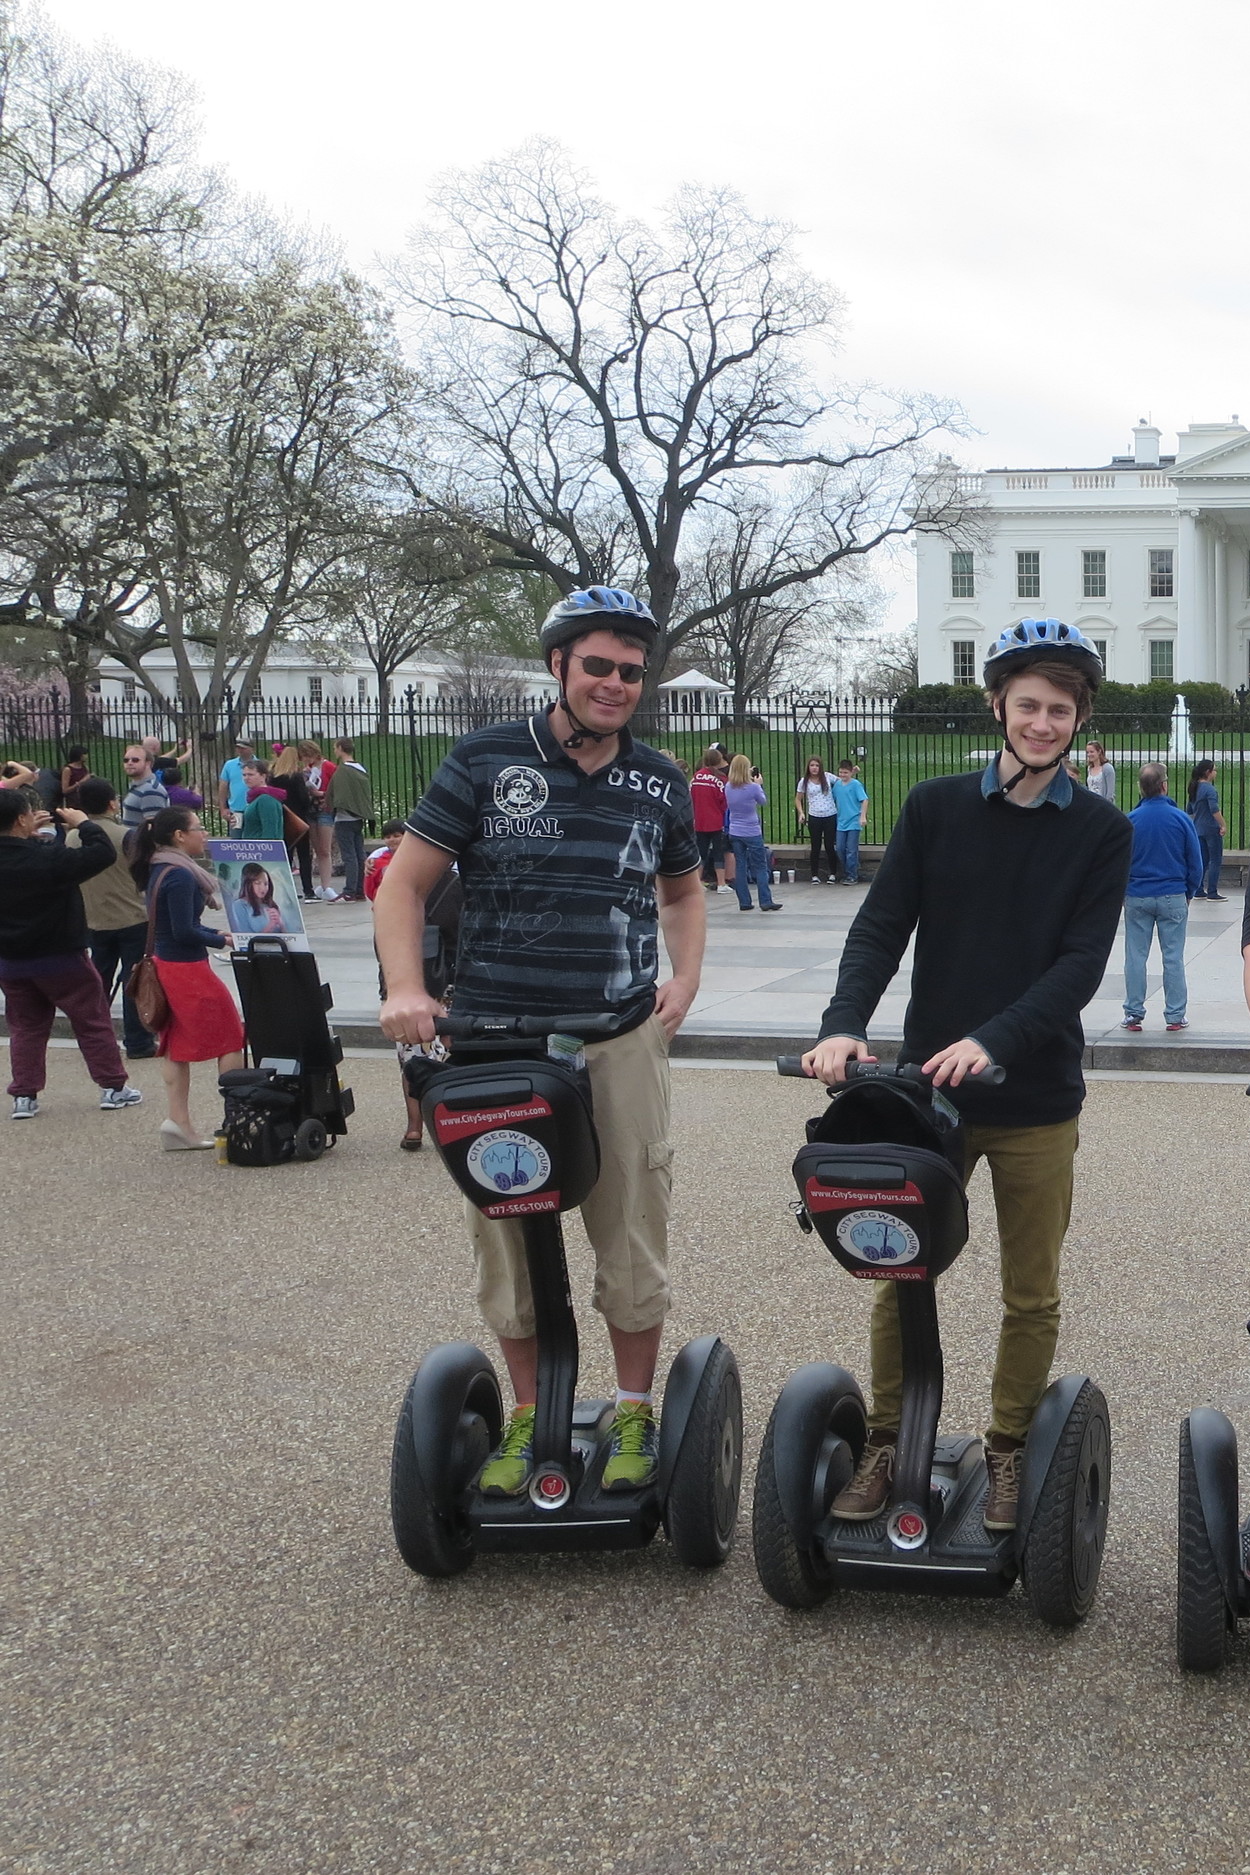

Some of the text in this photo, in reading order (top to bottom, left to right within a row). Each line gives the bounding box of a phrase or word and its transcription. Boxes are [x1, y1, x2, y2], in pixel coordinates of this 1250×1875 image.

[696, 773, 725, 792] CAPITOL
[483, 816, 564, 838] IGUAL
[220, 843, 255, 851] SHOULD
[236, 852, 262, 860] PRAY?
[440, 1106, 546, 1127] www.CitySegwayTours.com
[469, 1131, 549, 1178] CITY SEGWAY TOURS
[811, 1189, 918, 1203] www.CitySegwayTours.com
[488, 1200, 556, 1215] 877-SEG-TOUR
[838, 1211, 919, 1255] CITY SEGWAY TOURS
[856, 1270, 921, 1280] 877-SEG-TOUR
